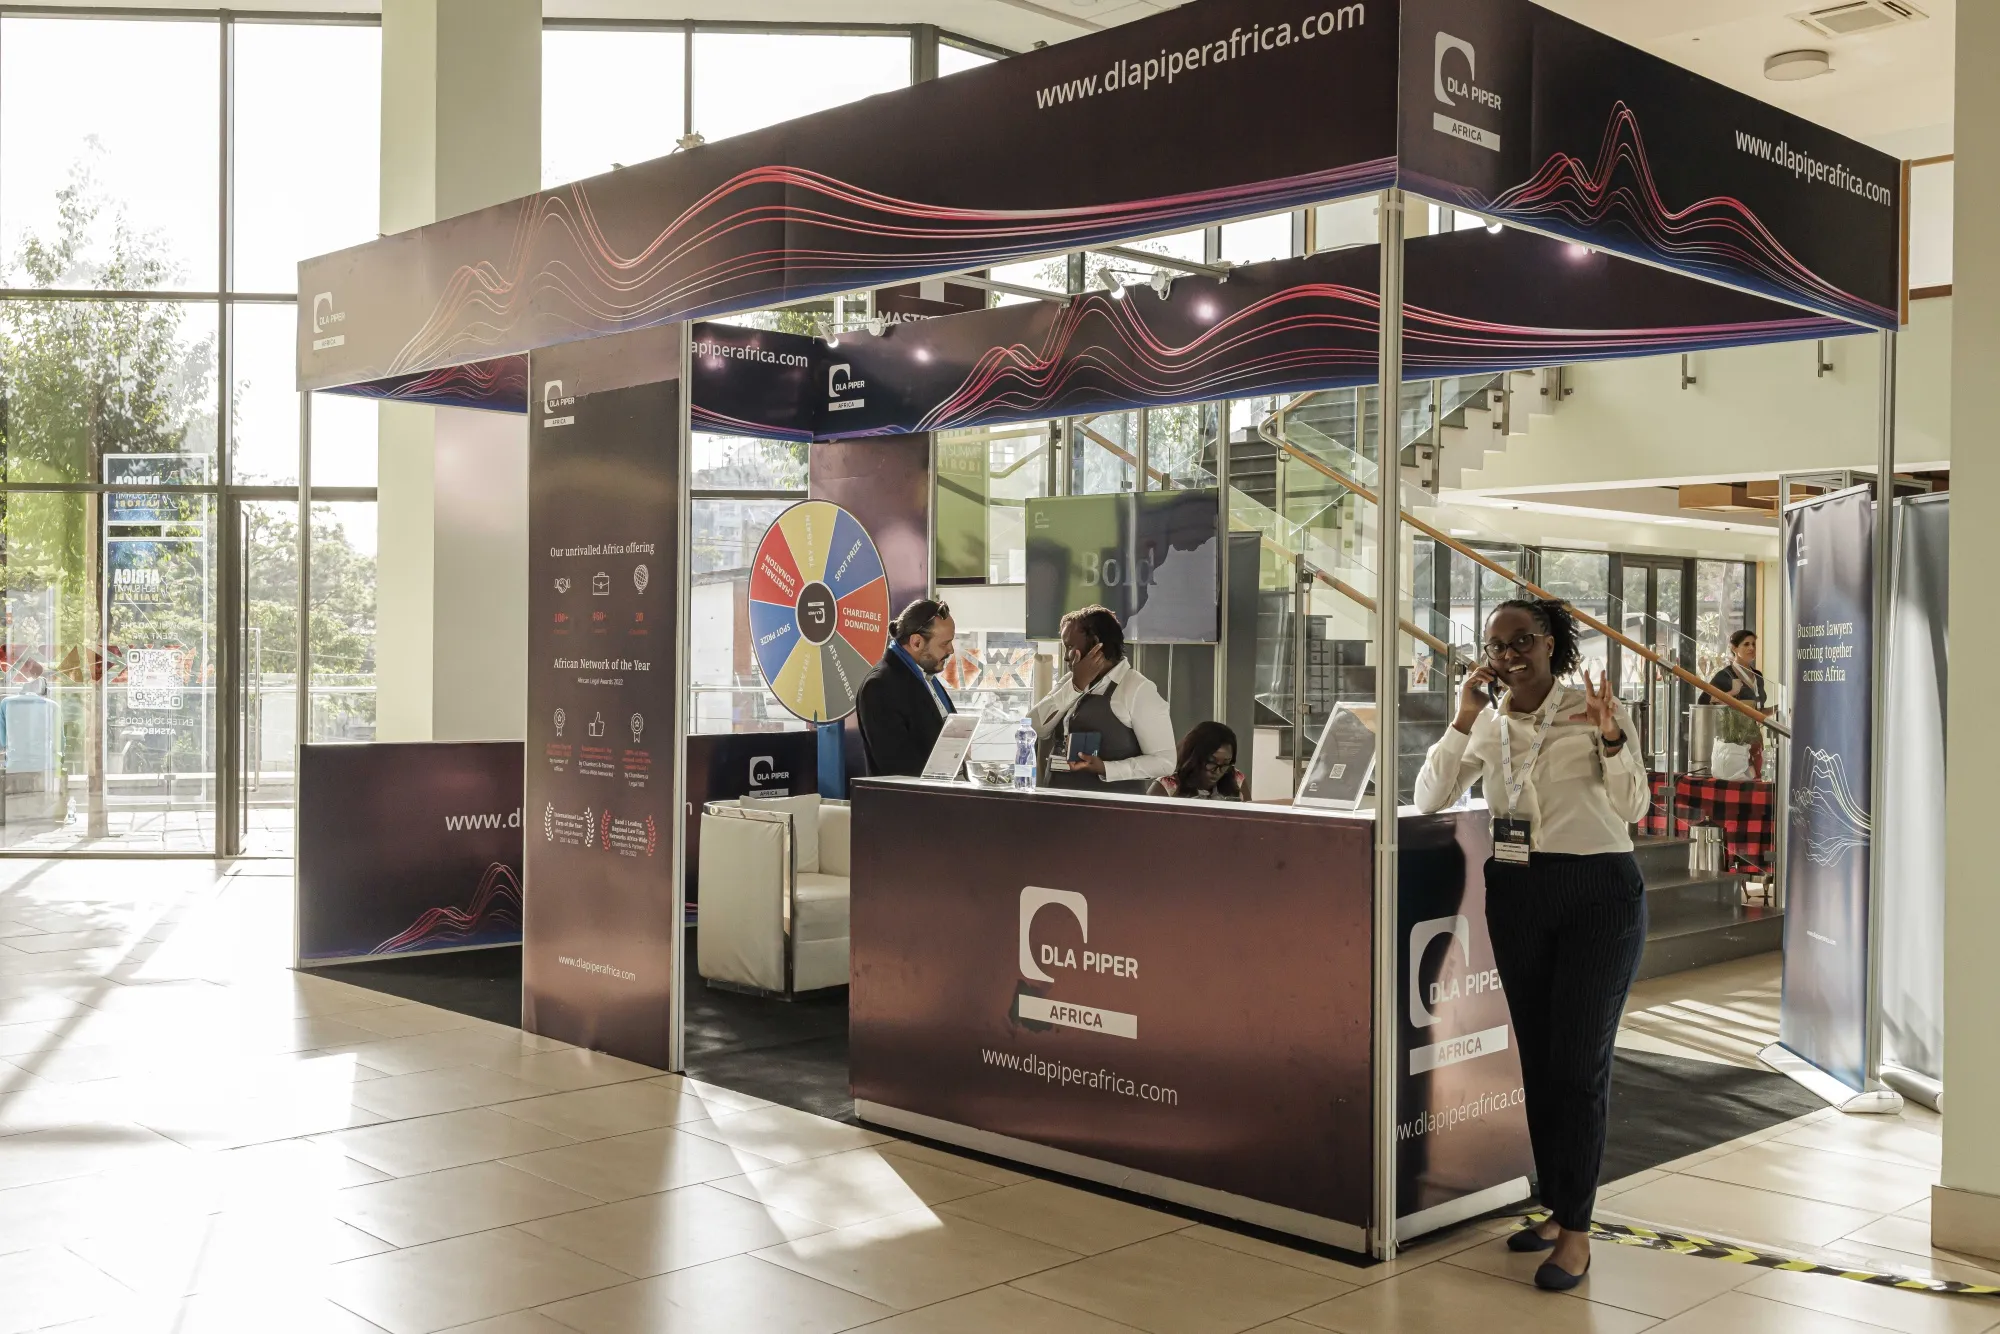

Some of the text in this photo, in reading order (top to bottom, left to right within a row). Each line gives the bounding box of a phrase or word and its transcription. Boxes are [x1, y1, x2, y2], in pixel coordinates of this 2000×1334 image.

[1036, 2, 1366, 109] www.dlapiperafrica.com
[1447, 76, 1502, 110] DLA PIPER
[1452, 123, 1482, 142] AFRICA
[1735, 130, 1891, 206] www.dlapiperafrica.com
[319, 312, 345, 325] DLA PIPER
[835, 380, 865, 391] DLA PIPER
[561, 397, 575, 406] PIPER
[550, 542, 655, 557] Our unrivalled Africa offering
[807, 551, 816, 568] TRY
[834, 539, 863, 582] SPOT PRIZE
[764, 553, 796, 586] DONATION
[1080, 548, 1157, 586] Bold
[761, 563, 794, 598] CHARITABLE
[842, 607, 881, 622] CHARITABLE
[759, 623, 791, 645] SPOT PRIZE
[844, 620, 880, 633] DONATION
[1797, 620, 1853, 639] Business lawyers
[553, 658, 651, 671] African Network of the Year
[1797, 643, 1853, 663] working together
[828, 644, 855, 701] ATS SURPRISE
[1803, 666, 1846, 682] across Africa
[445, 807, 520, 831] www.d
[628, 820, 642, 828] Leading
[558, 955, 636, 981] www.dlapiperafrica.com
[1041, 944, 1139, 979] DLA PIPER
[1429, 978, 1460, 1005] DLA
[1050, 1005, 1103, 1028] AFRICA
[1437, 1036, 1483, 1062] AFRICA
[982, 1048, 1178, 1106] www.dlapiperafrica.com
